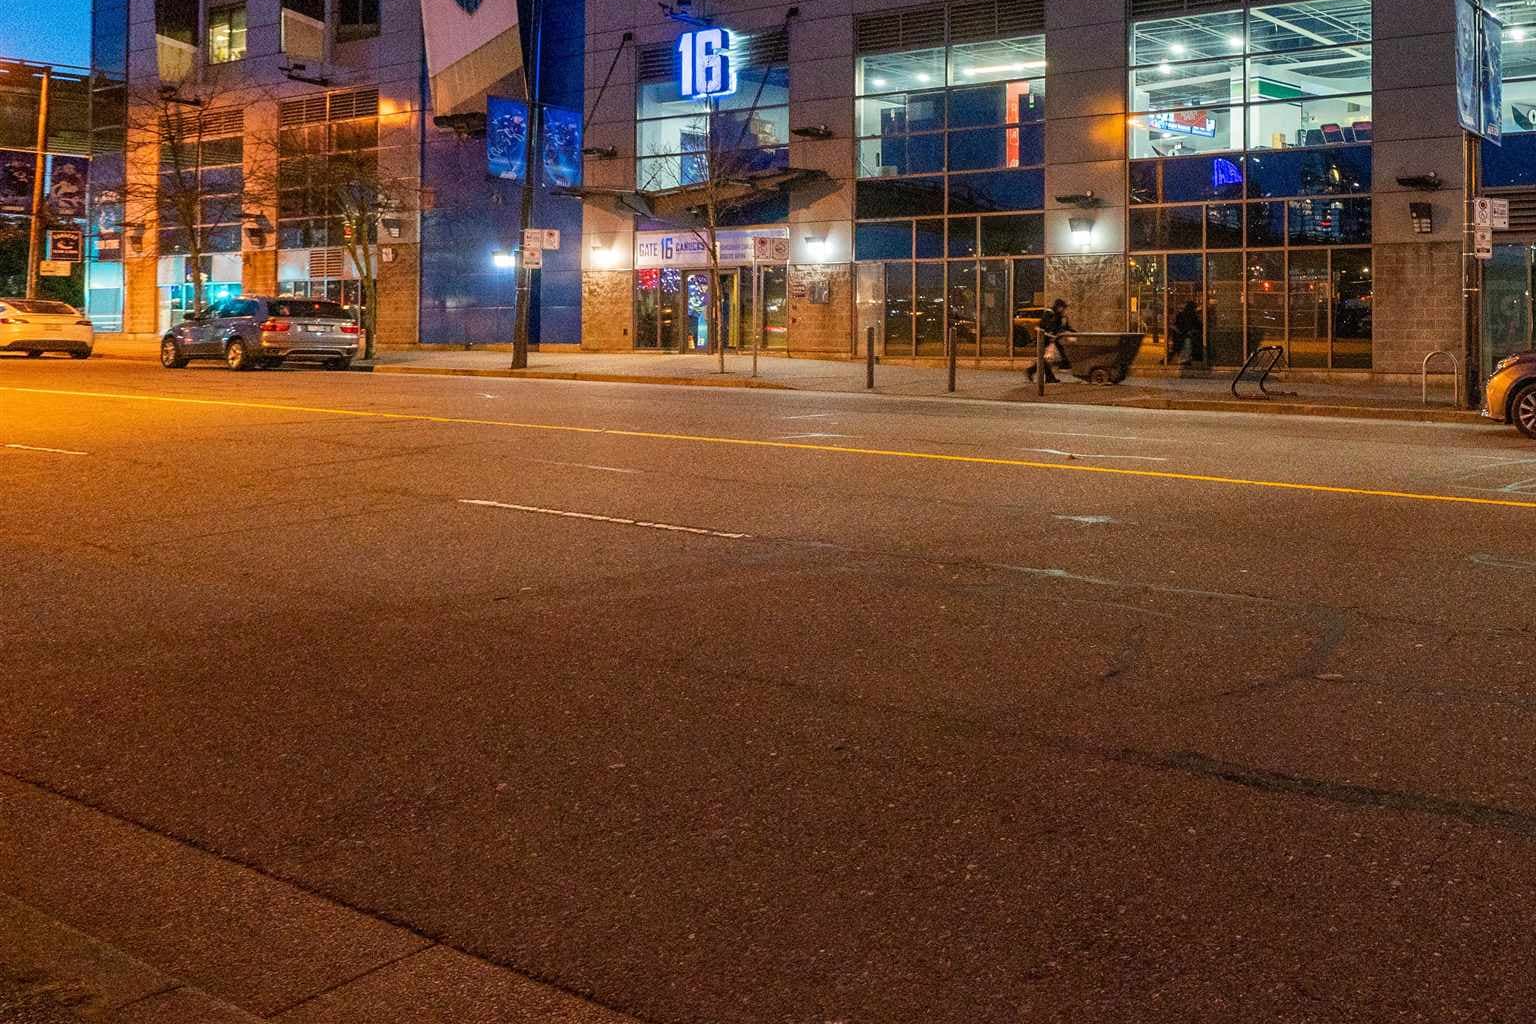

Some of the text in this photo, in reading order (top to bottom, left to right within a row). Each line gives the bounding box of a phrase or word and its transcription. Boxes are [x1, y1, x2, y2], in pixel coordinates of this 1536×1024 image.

[678, 28, 727, 96] 16
[639, 241, 658, 257] GATE
[661, 236, 674, 260] 16
